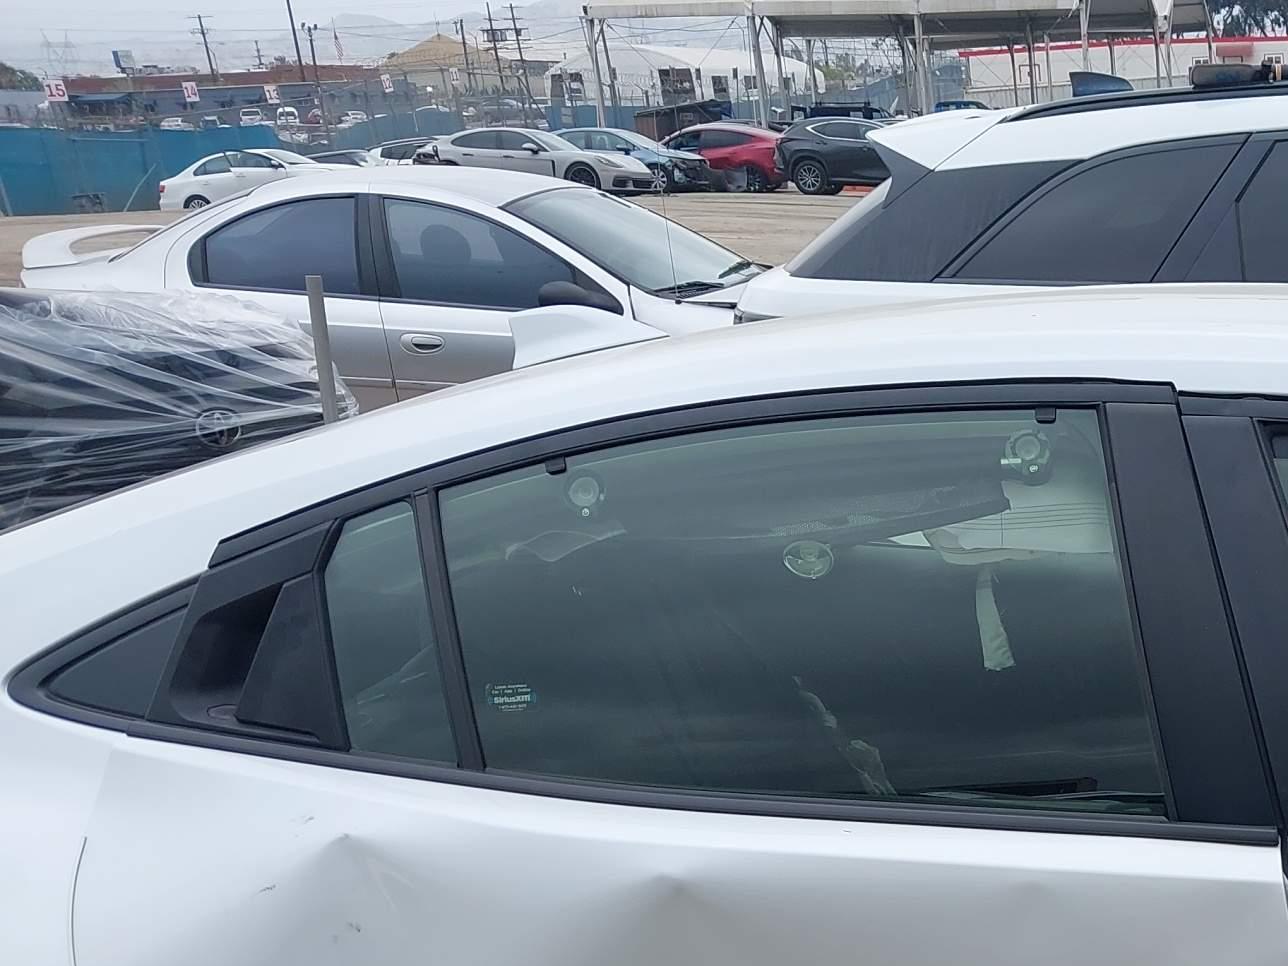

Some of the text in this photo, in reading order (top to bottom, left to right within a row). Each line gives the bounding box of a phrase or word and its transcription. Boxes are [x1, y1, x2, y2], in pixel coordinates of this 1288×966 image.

[450, 71, 459, 81] 11
[382, 77, 392, 89] 12
[45, 83, 66, 98] 15
[184, 86, 198, 98] 14
[265, 88, 280, 100] 13
